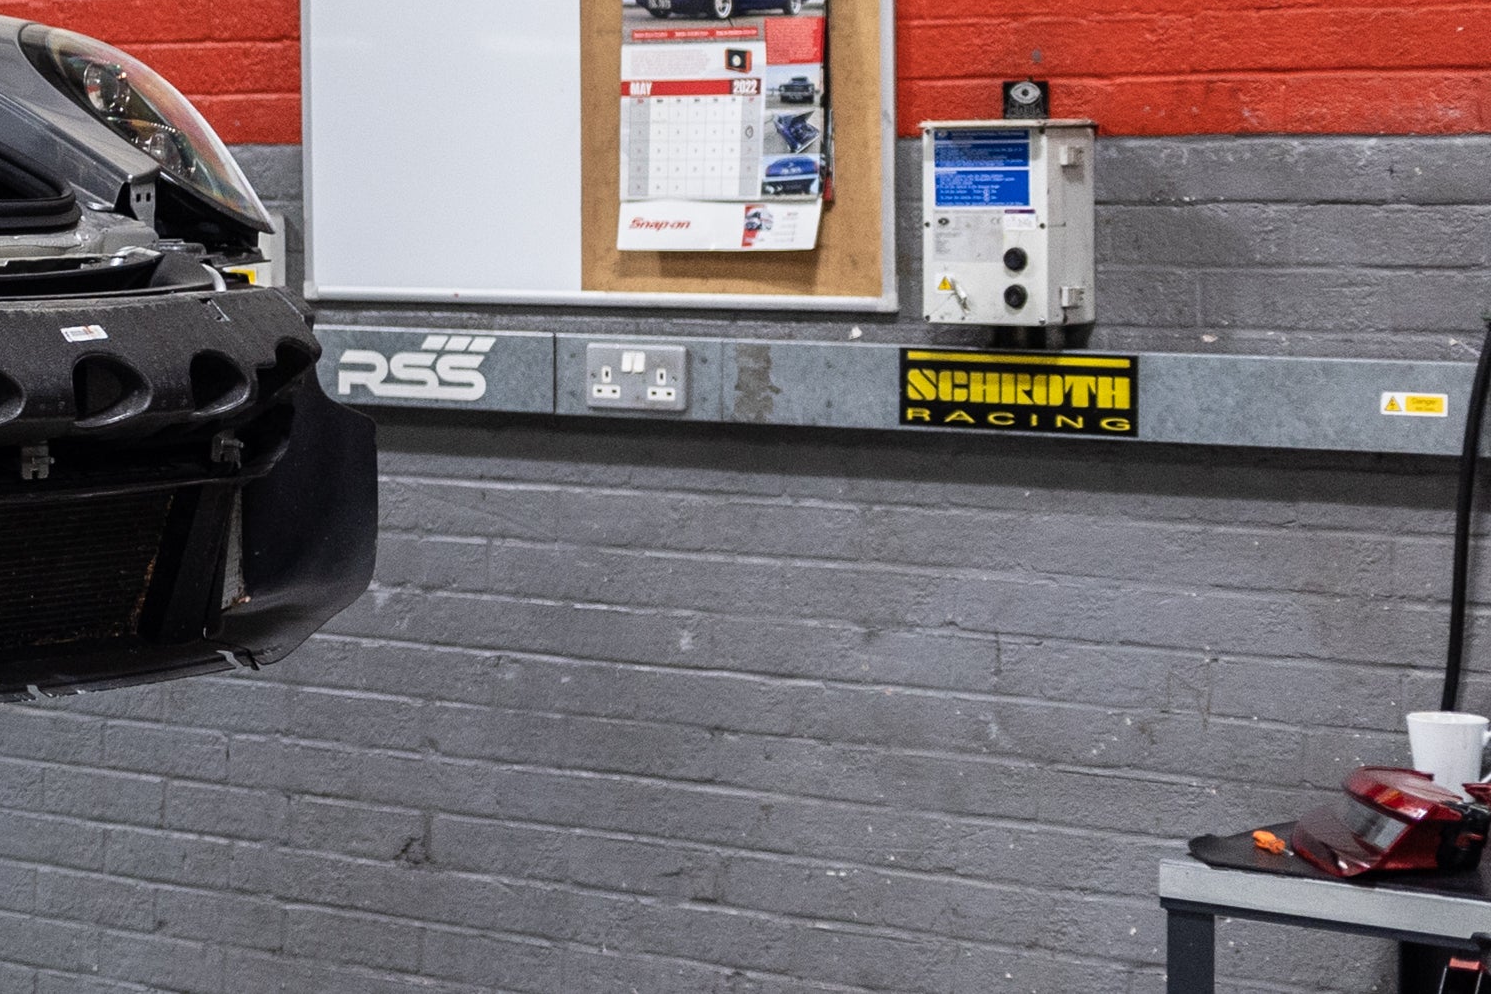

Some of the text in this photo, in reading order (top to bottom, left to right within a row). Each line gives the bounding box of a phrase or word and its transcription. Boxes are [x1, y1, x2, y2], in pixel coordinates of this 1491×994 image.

[629, 77, 758, 97] MAY 2022
[629, 217, 691, 231] Snap-on
[338, 349, 486, 401] RSS
[908, 368, 1130, 410] SCHROTH
[907, 407, 1131, 431] RACING
